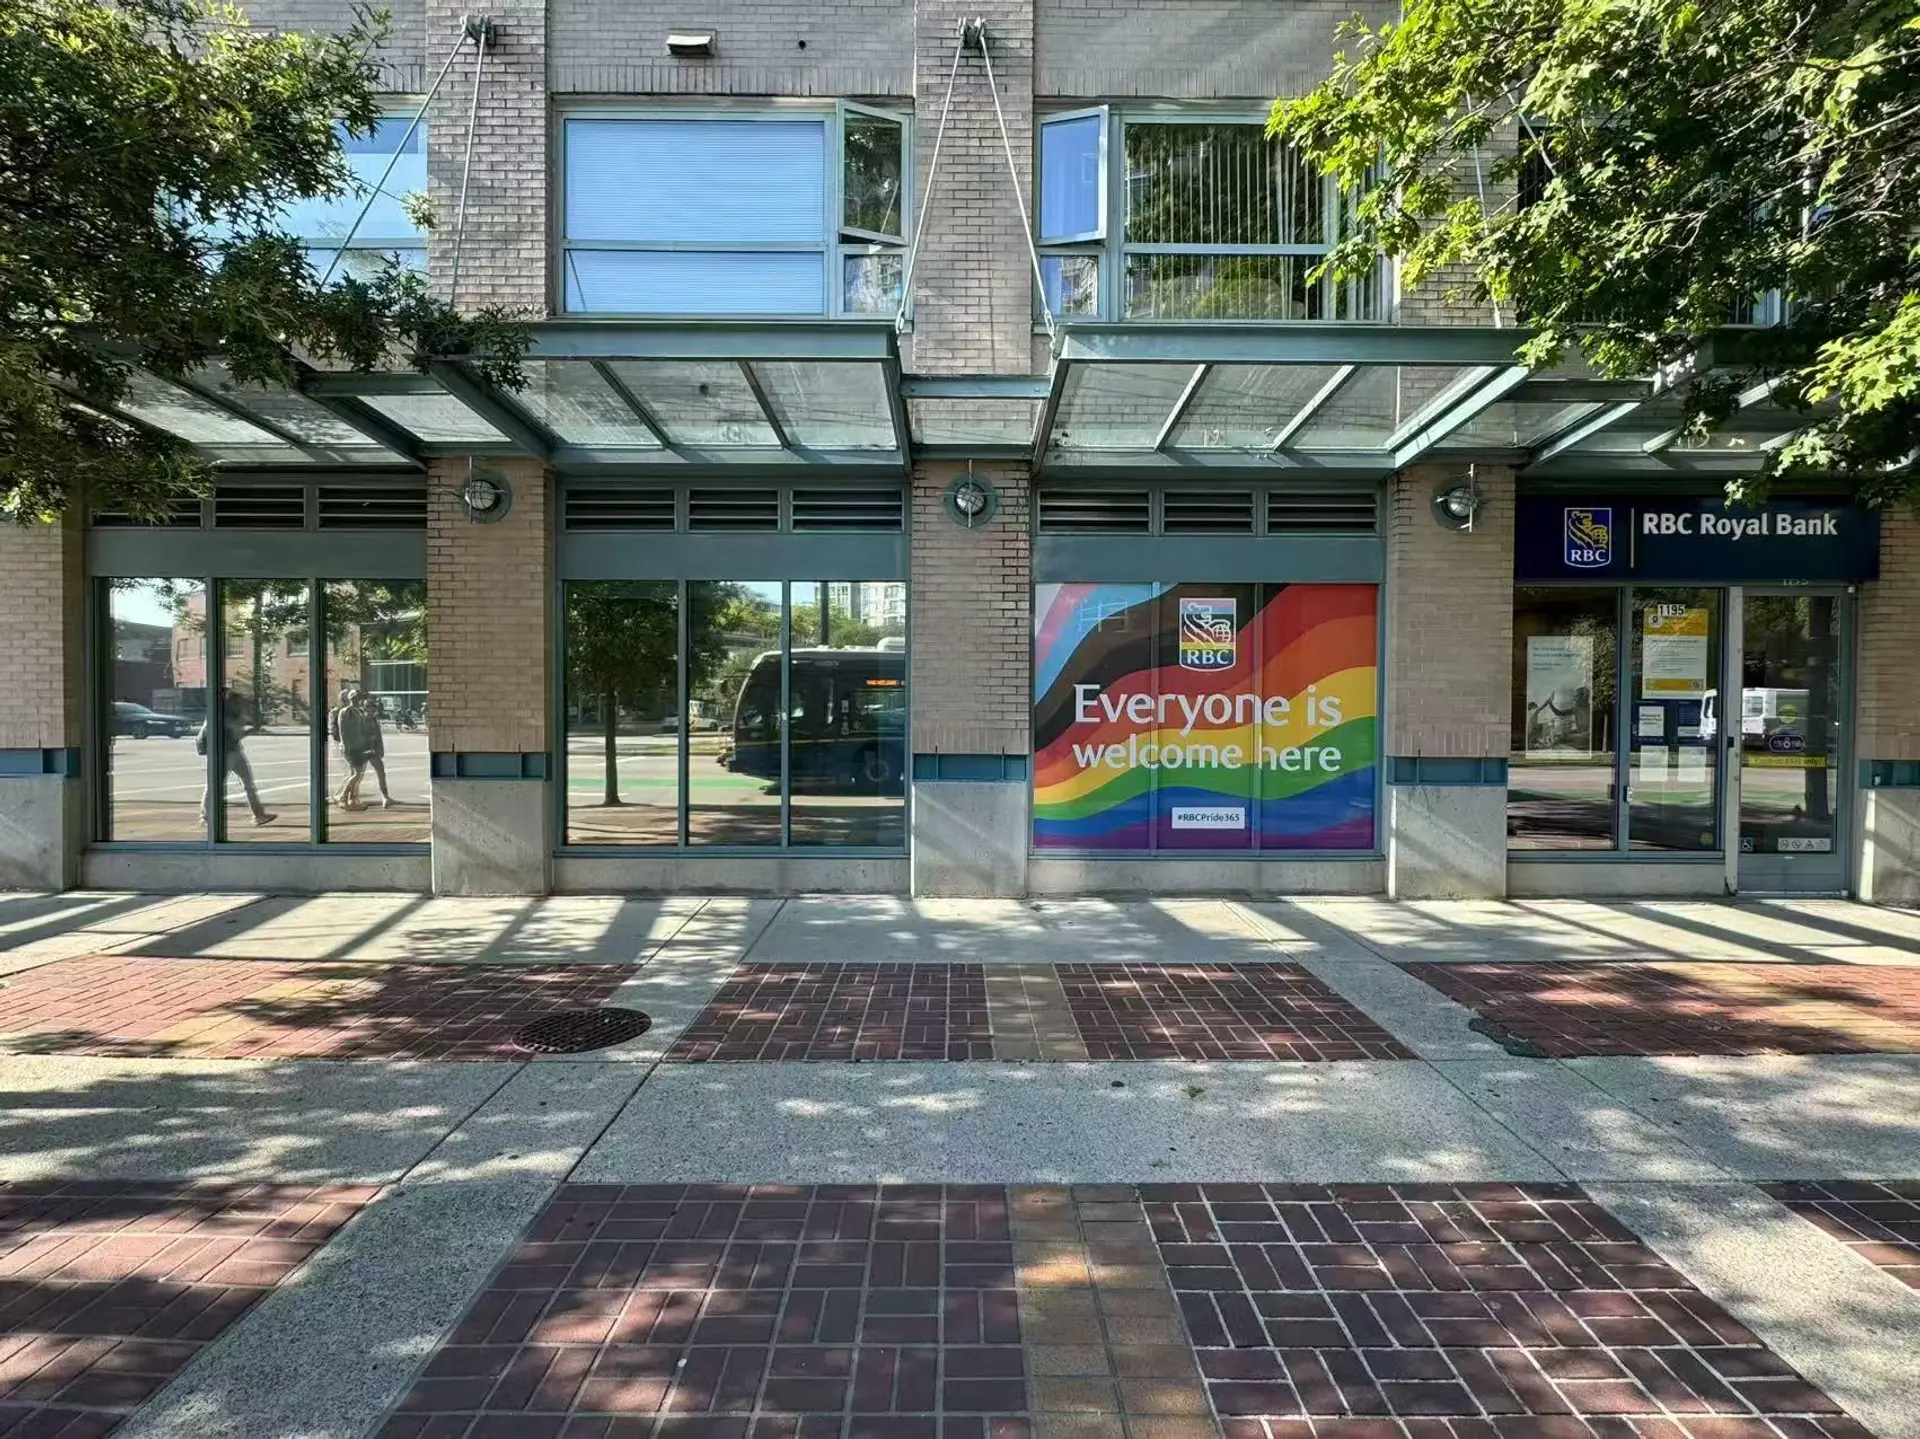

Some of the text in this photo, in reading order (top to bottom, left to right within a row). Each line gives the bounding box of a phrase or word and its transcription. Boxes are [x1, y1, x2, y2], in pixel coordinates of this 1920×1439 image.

[1643, 512, 1838, 540] RBC Royal Bank
[1571, 549, 1607, 562] RBC
[1660, 604, 1685, 616] 1195
[1186, 650, 1230, 665] RBC
[1073, 683, 1342, 736] Everyone is
[1072, 733, 1342, 772] welcome here
[1177, 812, 1241, 823] #RBCPride365
